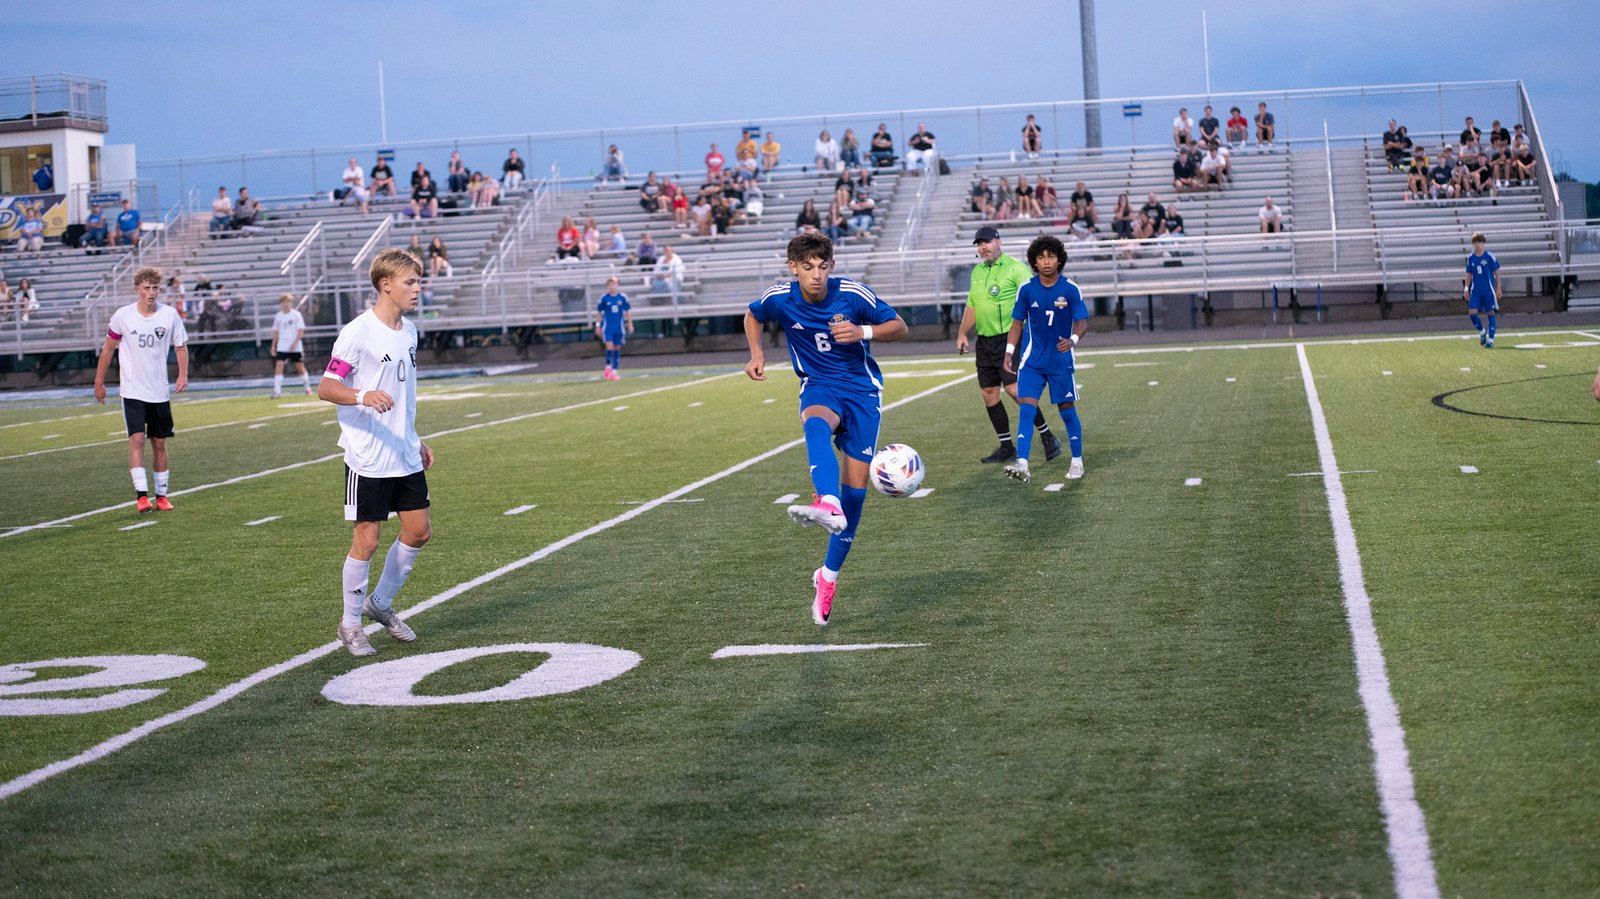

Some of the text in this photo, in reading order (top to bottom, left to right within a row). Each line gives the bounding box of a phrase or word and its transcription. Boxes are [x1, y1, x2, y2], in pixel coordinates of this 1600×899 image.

[1045, 310, 1055, 326] 7
[138, 334, 154, 348] 50
[814, 333, 831, 352] 6
[328, 360, 340, 371] C
[397, 360, 406, 382] 0
